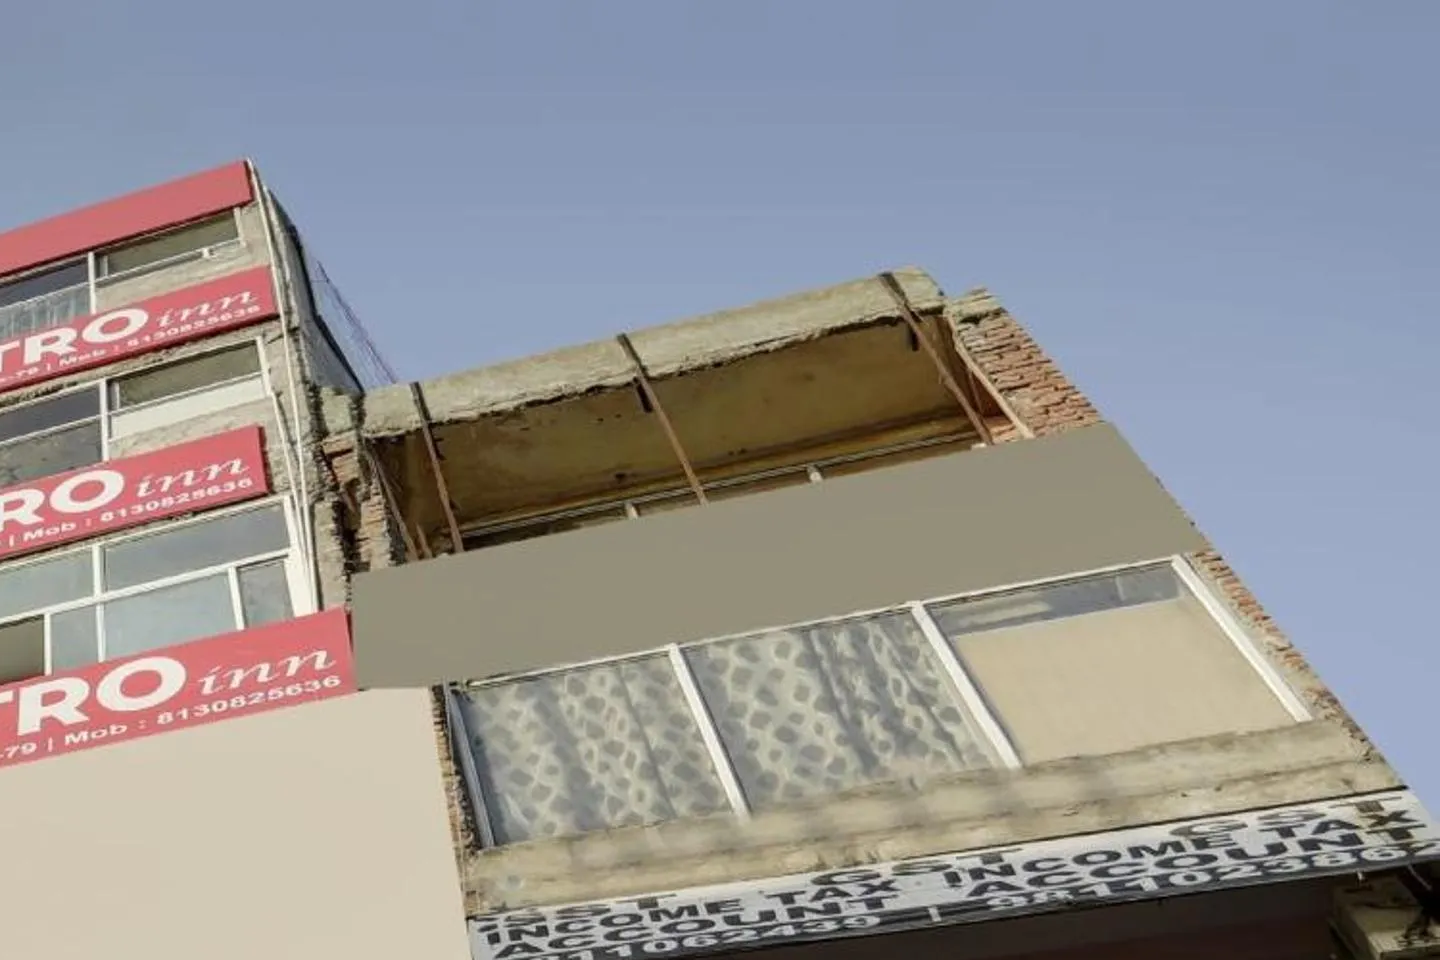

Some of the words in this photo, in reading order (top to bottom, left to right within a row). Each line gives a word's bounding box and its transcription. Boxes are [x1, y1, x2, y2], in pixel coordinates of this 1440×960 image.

[157, 290, 258, 328] inn
[136, 457, 250, 498] inn
[23, 519, 76, 542] Mob
[198, 647, 336, 697] inn
[65, 720, 128, 745] Mob
[157, 674, 342, 726] 8130825636
[1169, 797, 1402, 836] GST
[811, 848, 1023, 886] GST
[943, 834, 1237, 887] INCOME
[1259, 810, 1419, 839] TAX
[968, 824, 1427, 896] ACCOUNT
[486, 898, 742, 945] INCOME
[767, 879, 901, 906] TAX
[494, 894, 900, 959] ACCOUNT
